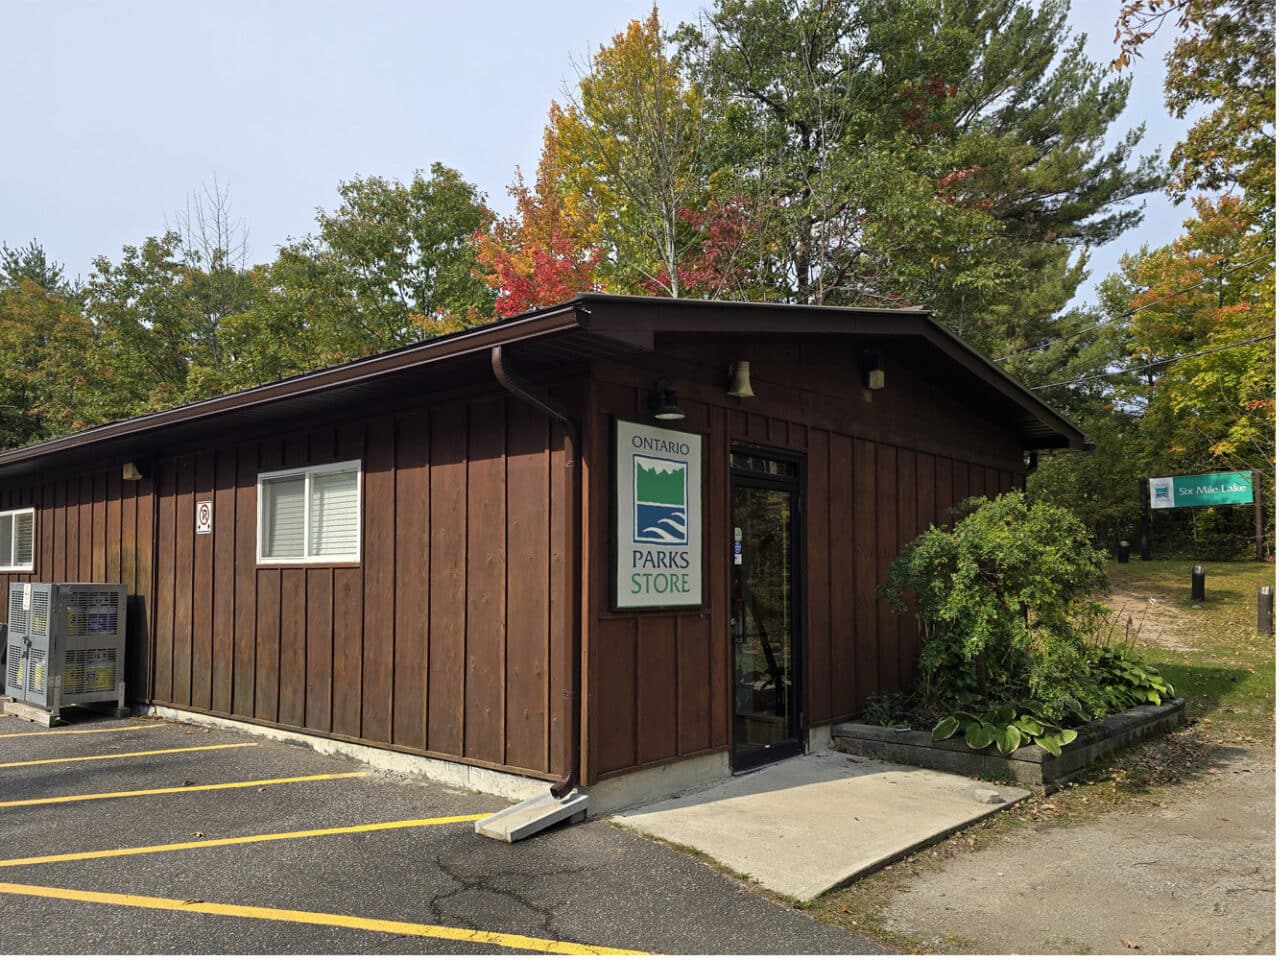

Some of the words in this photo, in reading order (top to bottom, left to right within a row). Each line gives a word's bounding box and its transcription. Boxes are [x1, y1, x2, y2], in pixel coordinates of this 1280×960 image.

[632, 435, 690, 455] ONTARIO
[1179, 487, 1193, 496] Six
[1196, 485, 1219, 495] Mile
[1221, 483, 1247, 493] Lake
[632, 550, 690, 569] PARKS
[631, 572, 690, 594] STORE
